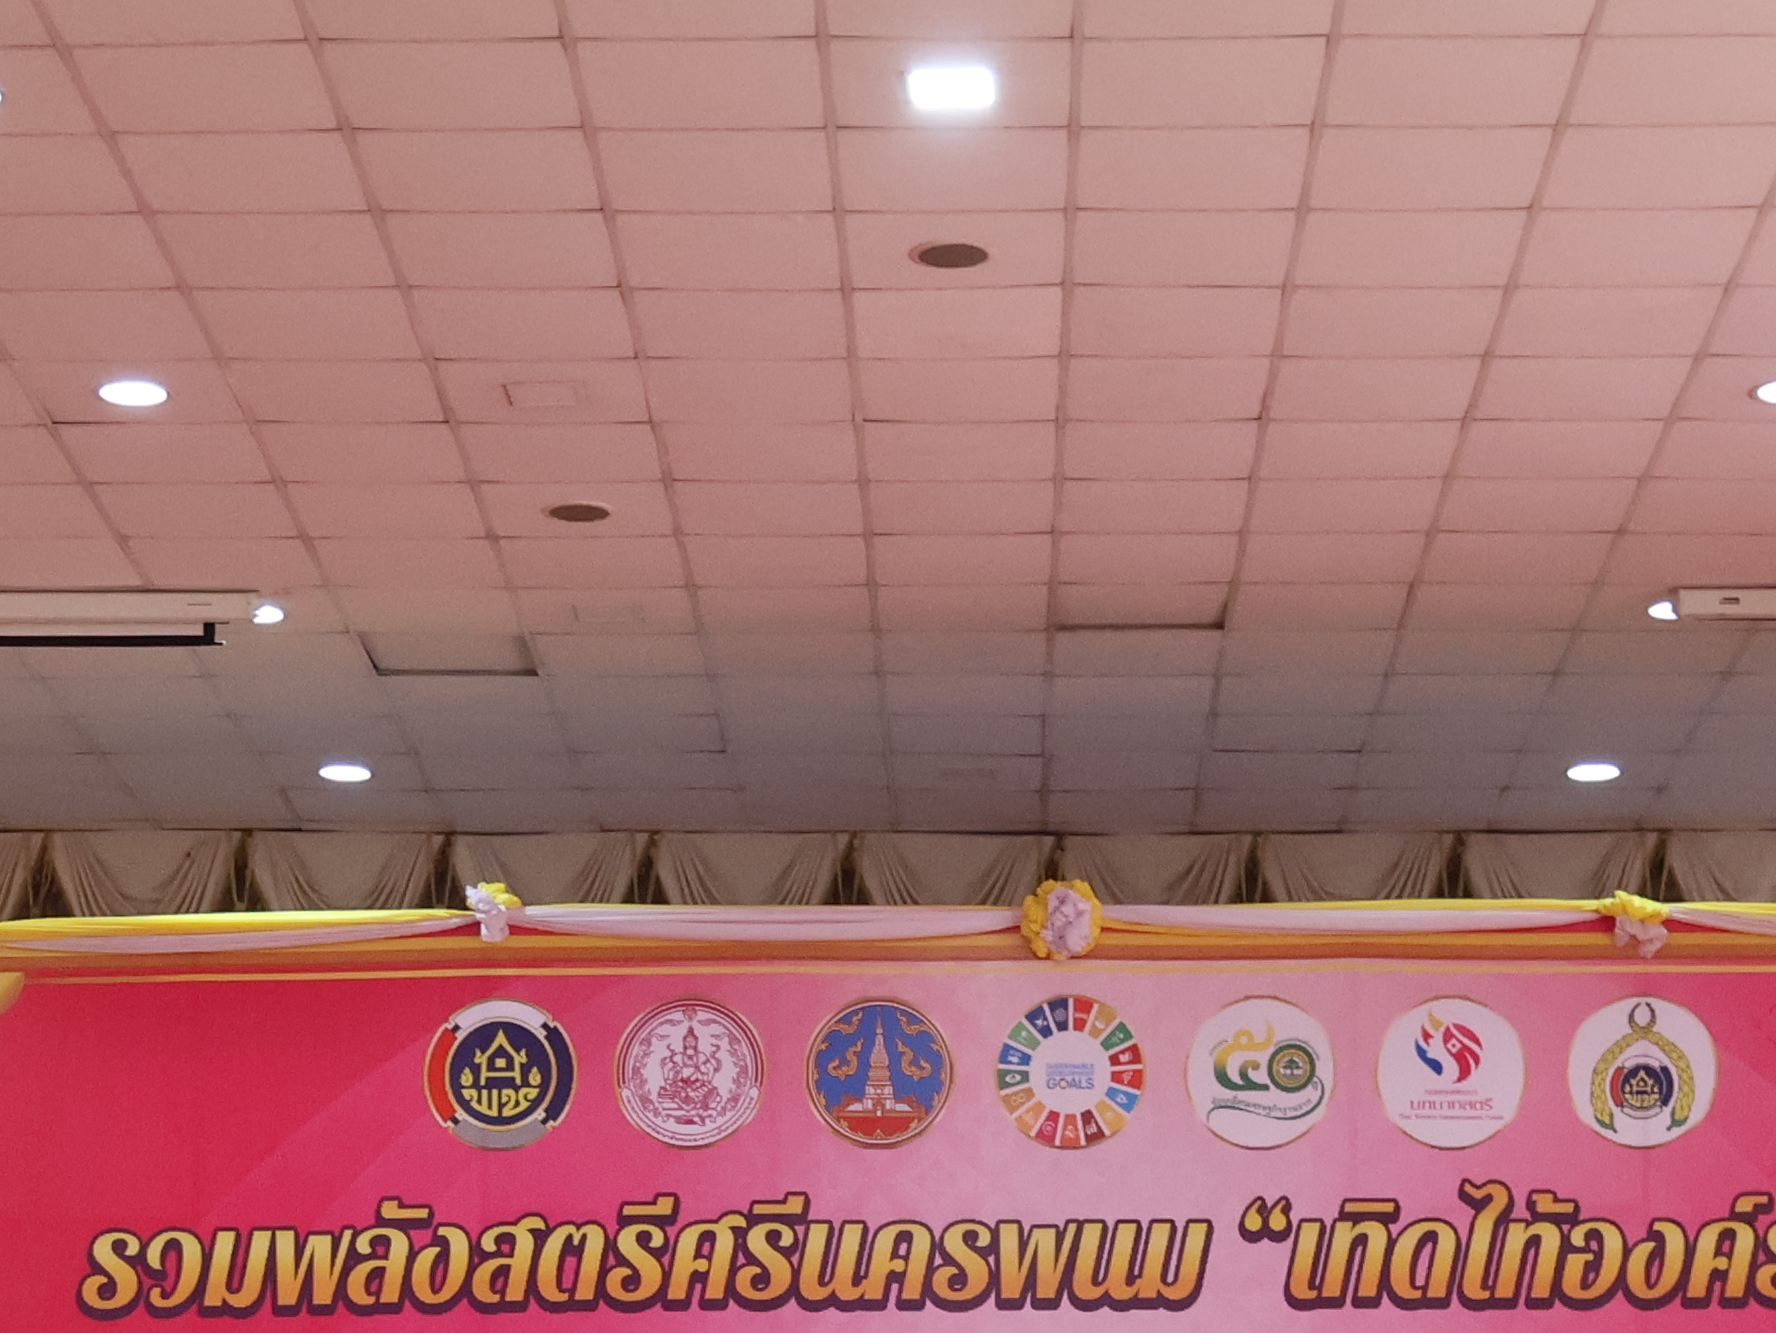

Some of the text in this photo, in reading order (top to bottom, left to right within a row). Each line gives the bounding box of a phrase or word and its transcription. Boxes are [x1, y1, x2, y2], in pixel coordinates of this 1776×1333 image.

[1047, 1077, 1094, 1089] GOALS
[78, 1192, 1212, 1320] รวมพลังสตรีศรีนครพนม
